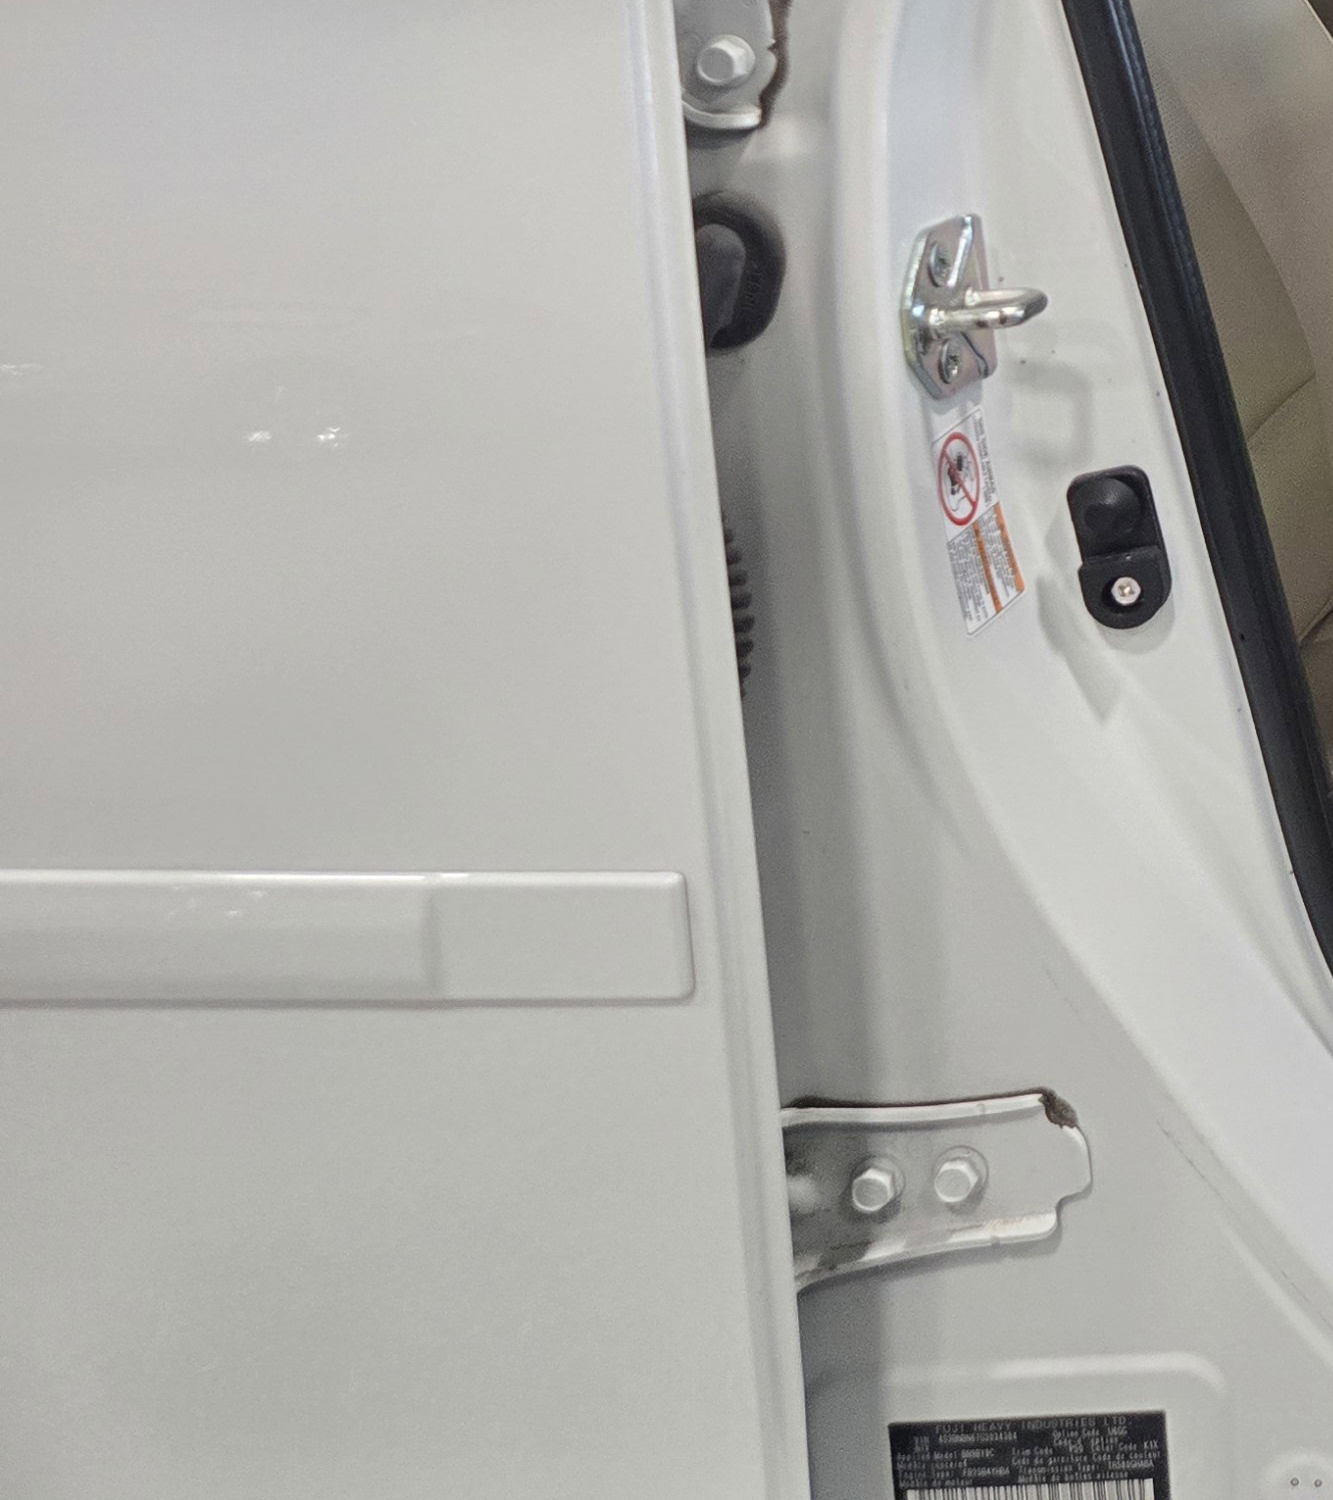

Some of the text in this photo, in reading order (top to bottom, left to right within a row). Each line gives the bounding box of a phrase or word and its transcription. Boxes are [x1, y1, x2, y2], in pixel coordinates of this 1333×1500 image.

[935, 1423, 965, 1434] FUJI
[973, 1421, 1011, 1431] HEAVY
[1021, 1417, 1096, 1430] INDUSTRIES
